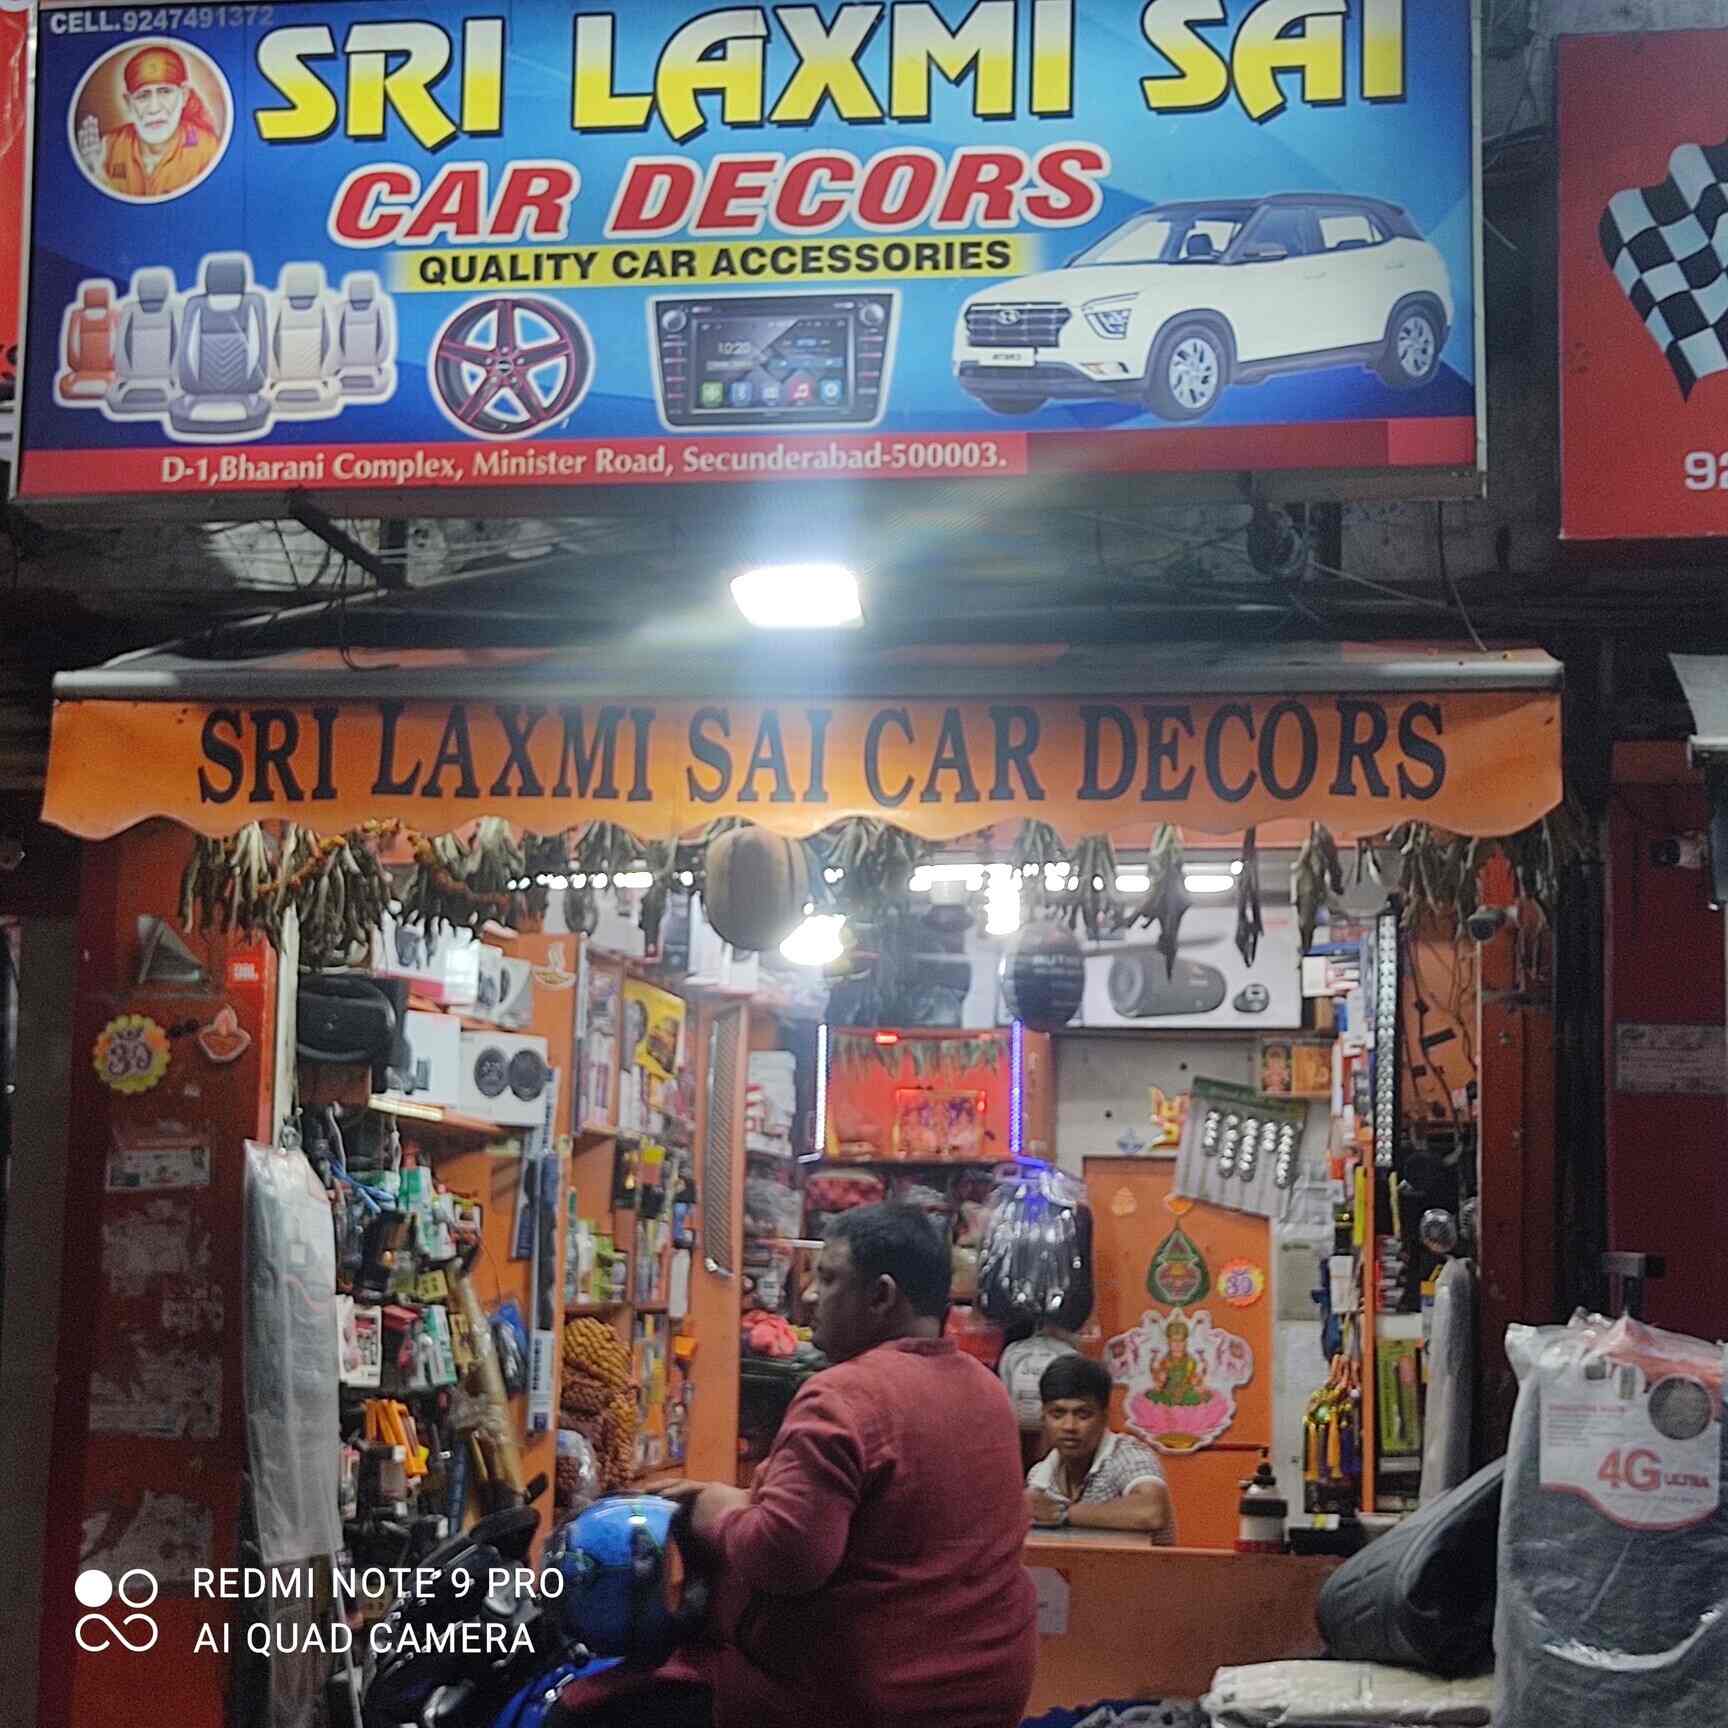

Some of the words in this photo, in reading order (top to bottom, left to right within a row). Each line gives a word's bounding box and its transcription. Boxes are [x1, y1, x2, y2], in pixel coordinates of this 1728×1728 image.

[51, 6, 273, 33] CELL.9247491372
[254, 18, 503, 148] SRI
[573, 0, 1073, 142] LAXMI
[1140, 0, 1406, 123] SAI
[331, 161, 579, 245] CAR
[607, 144, 1107, 236] DECORS
[420, 251, 597, 284] QUALITY
[612, 249, 697, 279] CAR
[711, 241, 1011, 277] ACCESSORIES
[161, 453, 325, 487] D-1,Bharani
[332, 450, 464, 484] Complex,
[472, 449, 587, 476] Minister
[596, 446, 675, 477] Road,
[683, 441, 1008, 471] Secunderabad-500003.
[199, 708, 339, 804] SRI
[371, 703, 655, 801] LAXMI
[687, 706, 831, 803] SAI
[864, 706, 1043, 808] CAR
[1076, 702, 1447, 802] DECORS
[1597, 1448, 1665, 1492] 4G
